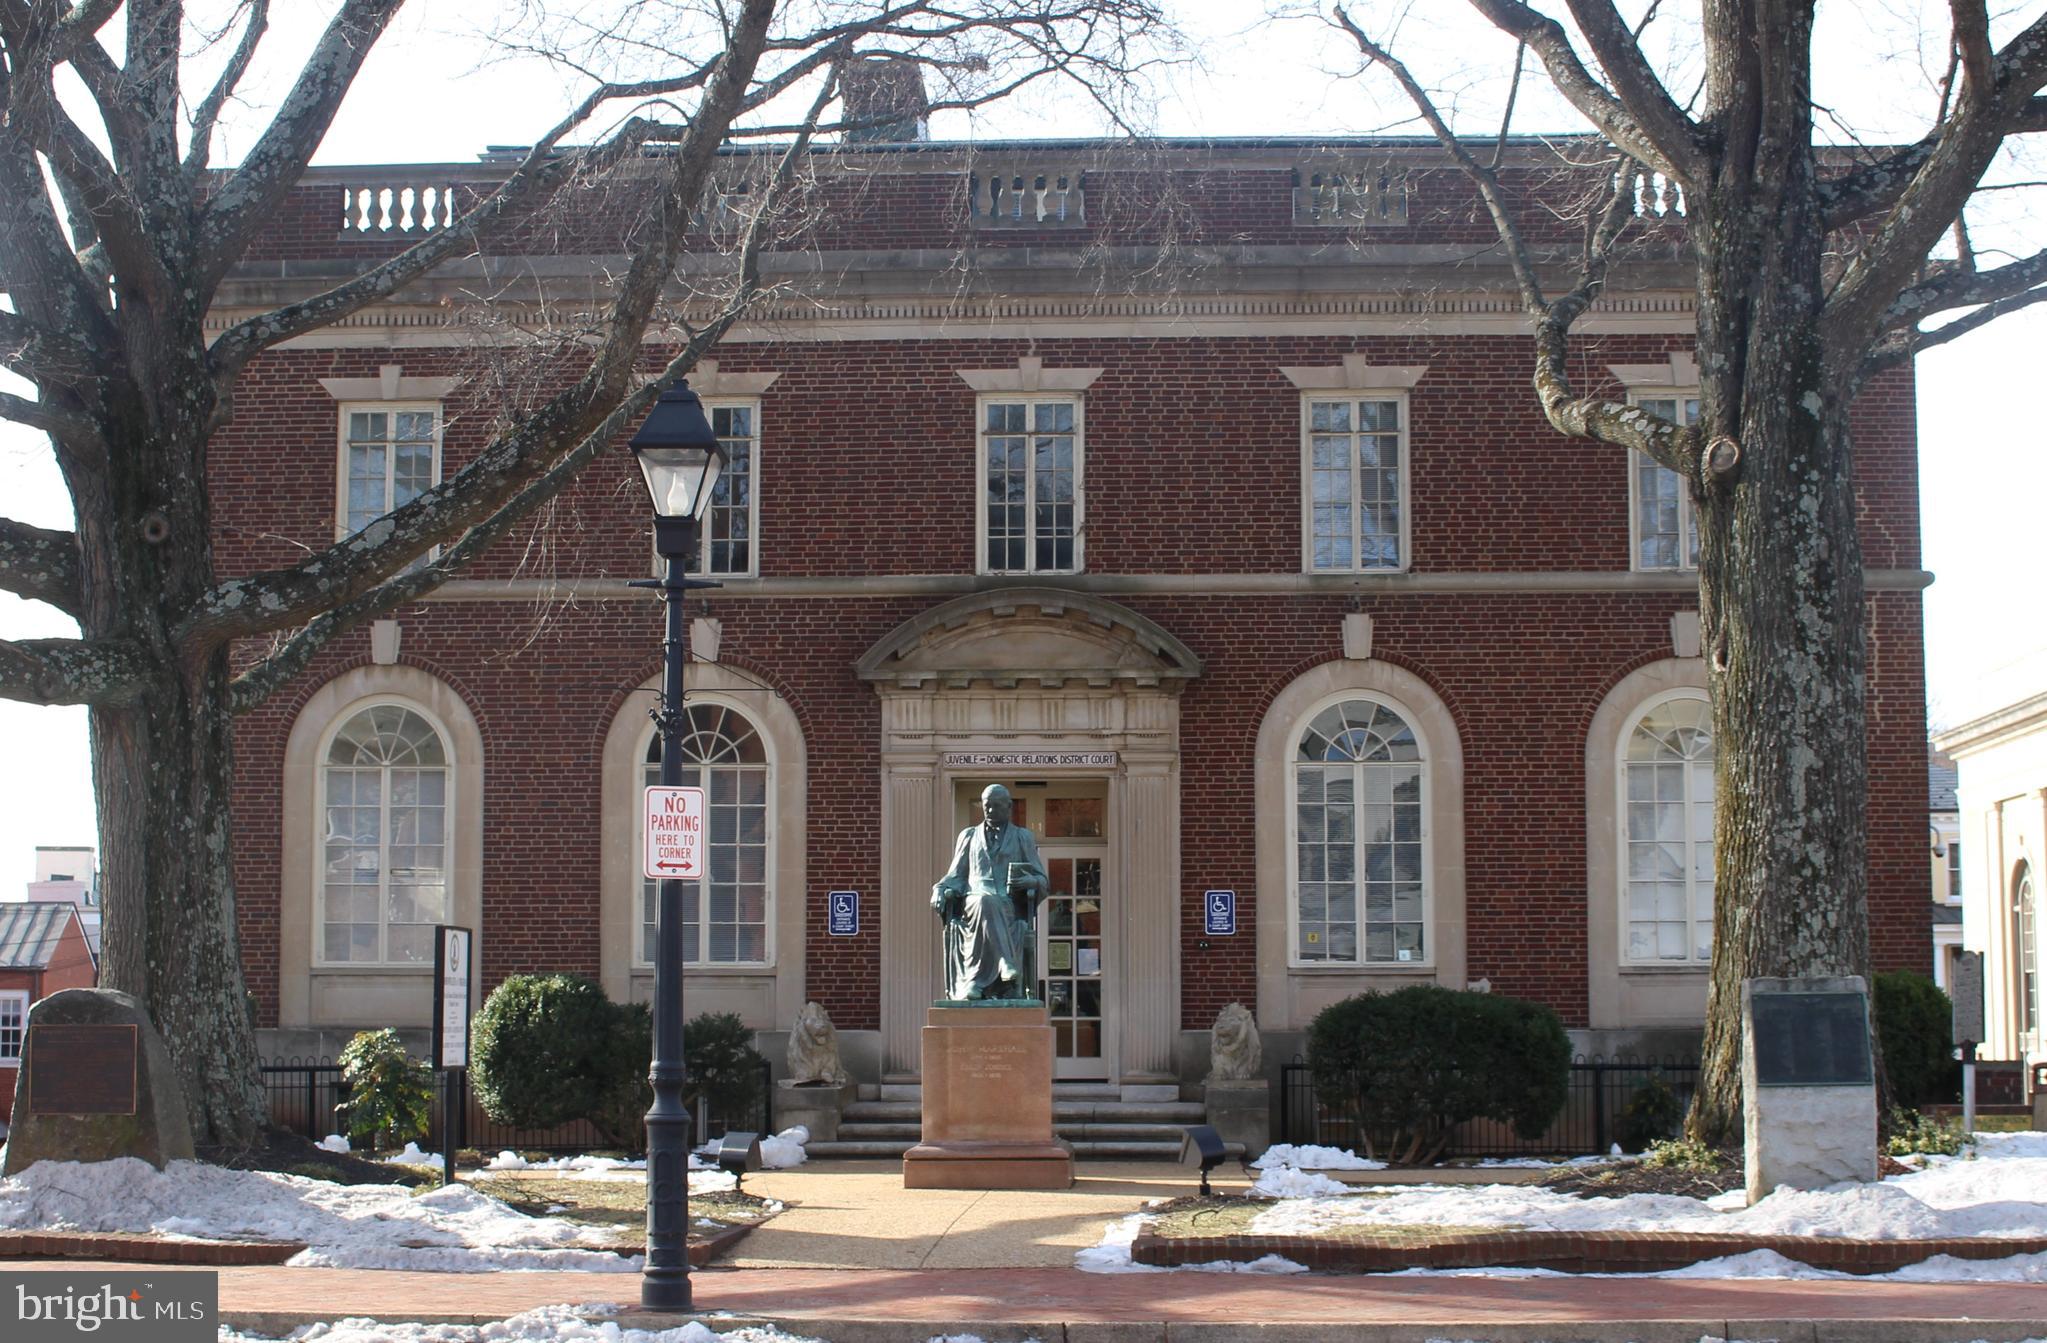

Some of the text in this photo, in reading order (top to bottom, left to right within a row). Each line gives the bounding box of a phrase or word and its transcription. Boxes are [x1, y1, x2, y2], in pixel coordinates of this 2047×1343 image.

[945, 755, 978, 764] JUVENILE
[987, 755, 1020, 764] DOMESTIC
[1022, 755, 1057, 764] RELATIONS
[1060, 755, 1089, 764] DISTRICT
[1091, 755, 1113, 764] COURT
[665, 797, 686, 813] NO
[651, 815, 699, 831] PARKING
[656, 834, 694, 846] HERE TO
[658, 847, 691, 859] CORNER
